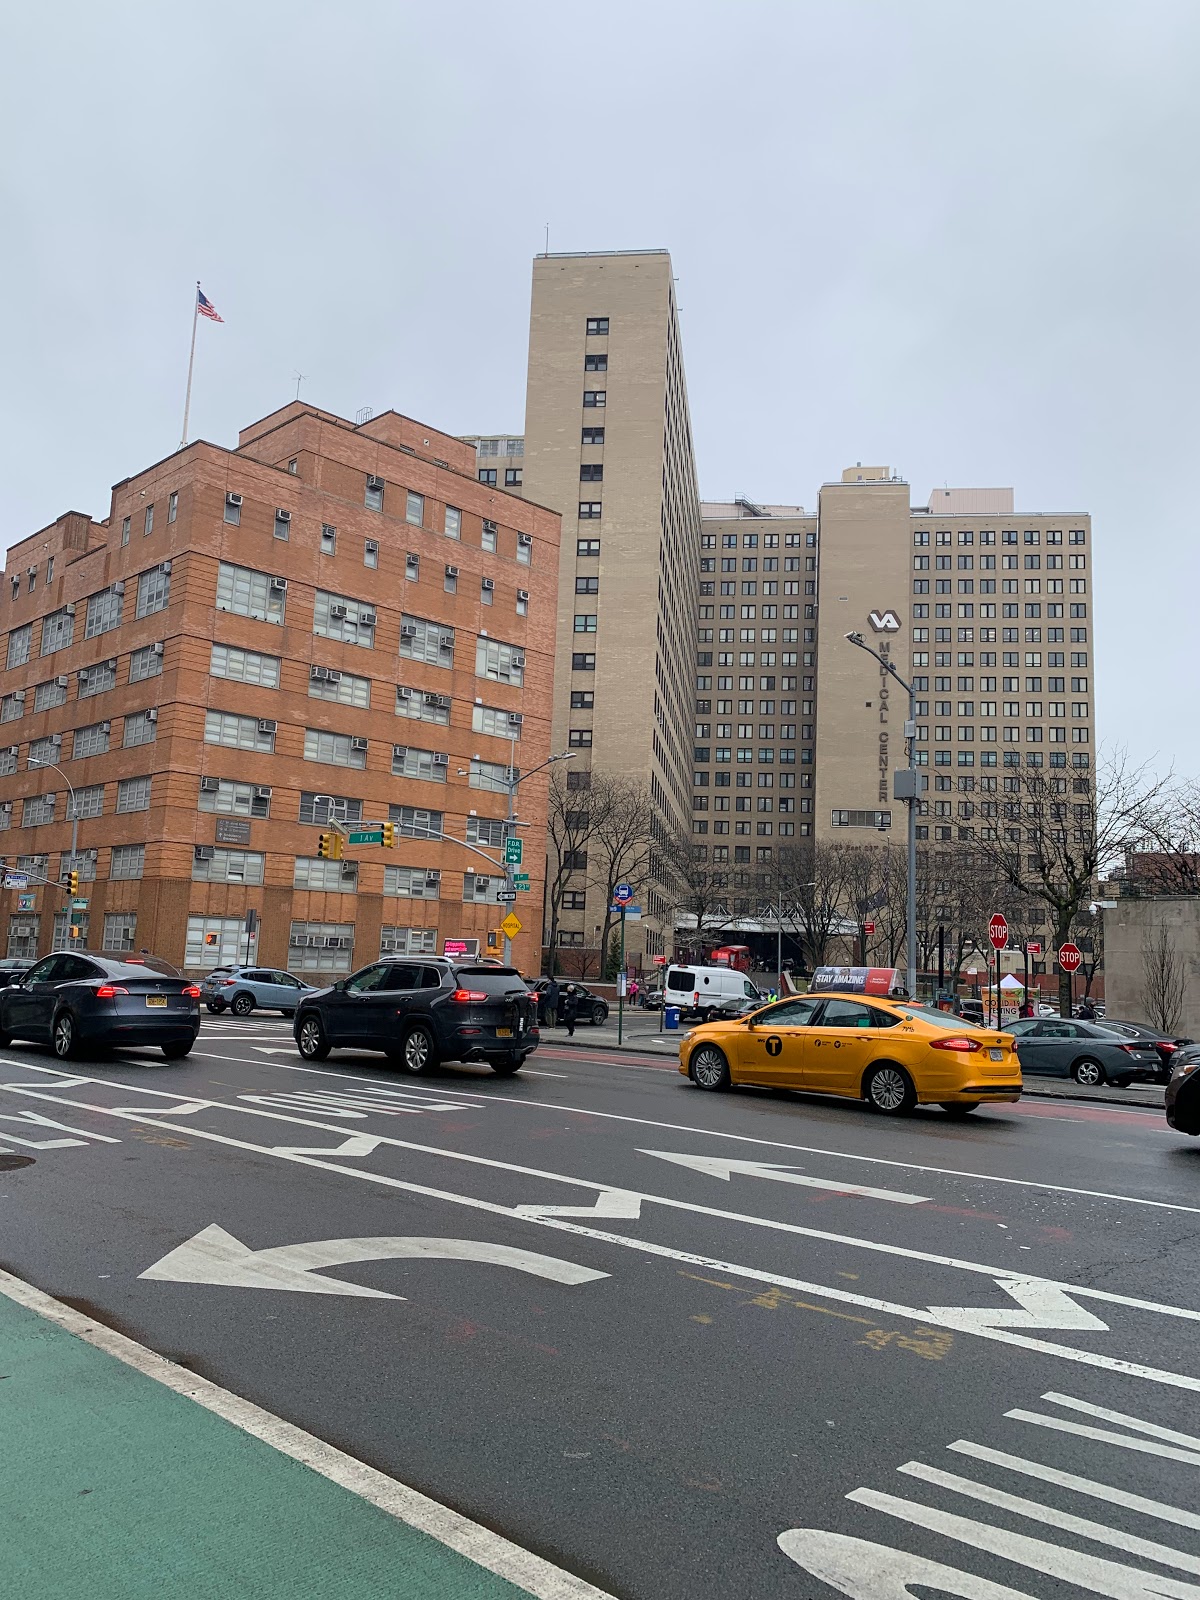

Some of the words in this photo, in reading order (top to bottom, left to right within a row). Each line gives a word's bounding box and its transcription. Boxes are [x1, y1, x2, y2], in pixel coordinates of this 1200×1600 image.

[869, 612, 901, 629] VA
[879, 731, 889, 802] CENTER
[990, 925, 1007, 939] STOP
[1060, 951, 1080, 963] STOP
[815, 974, 833, 983] STAY
[832, 974, 865, 984] AMAZING
[769, 1039, 779, 1054] T
